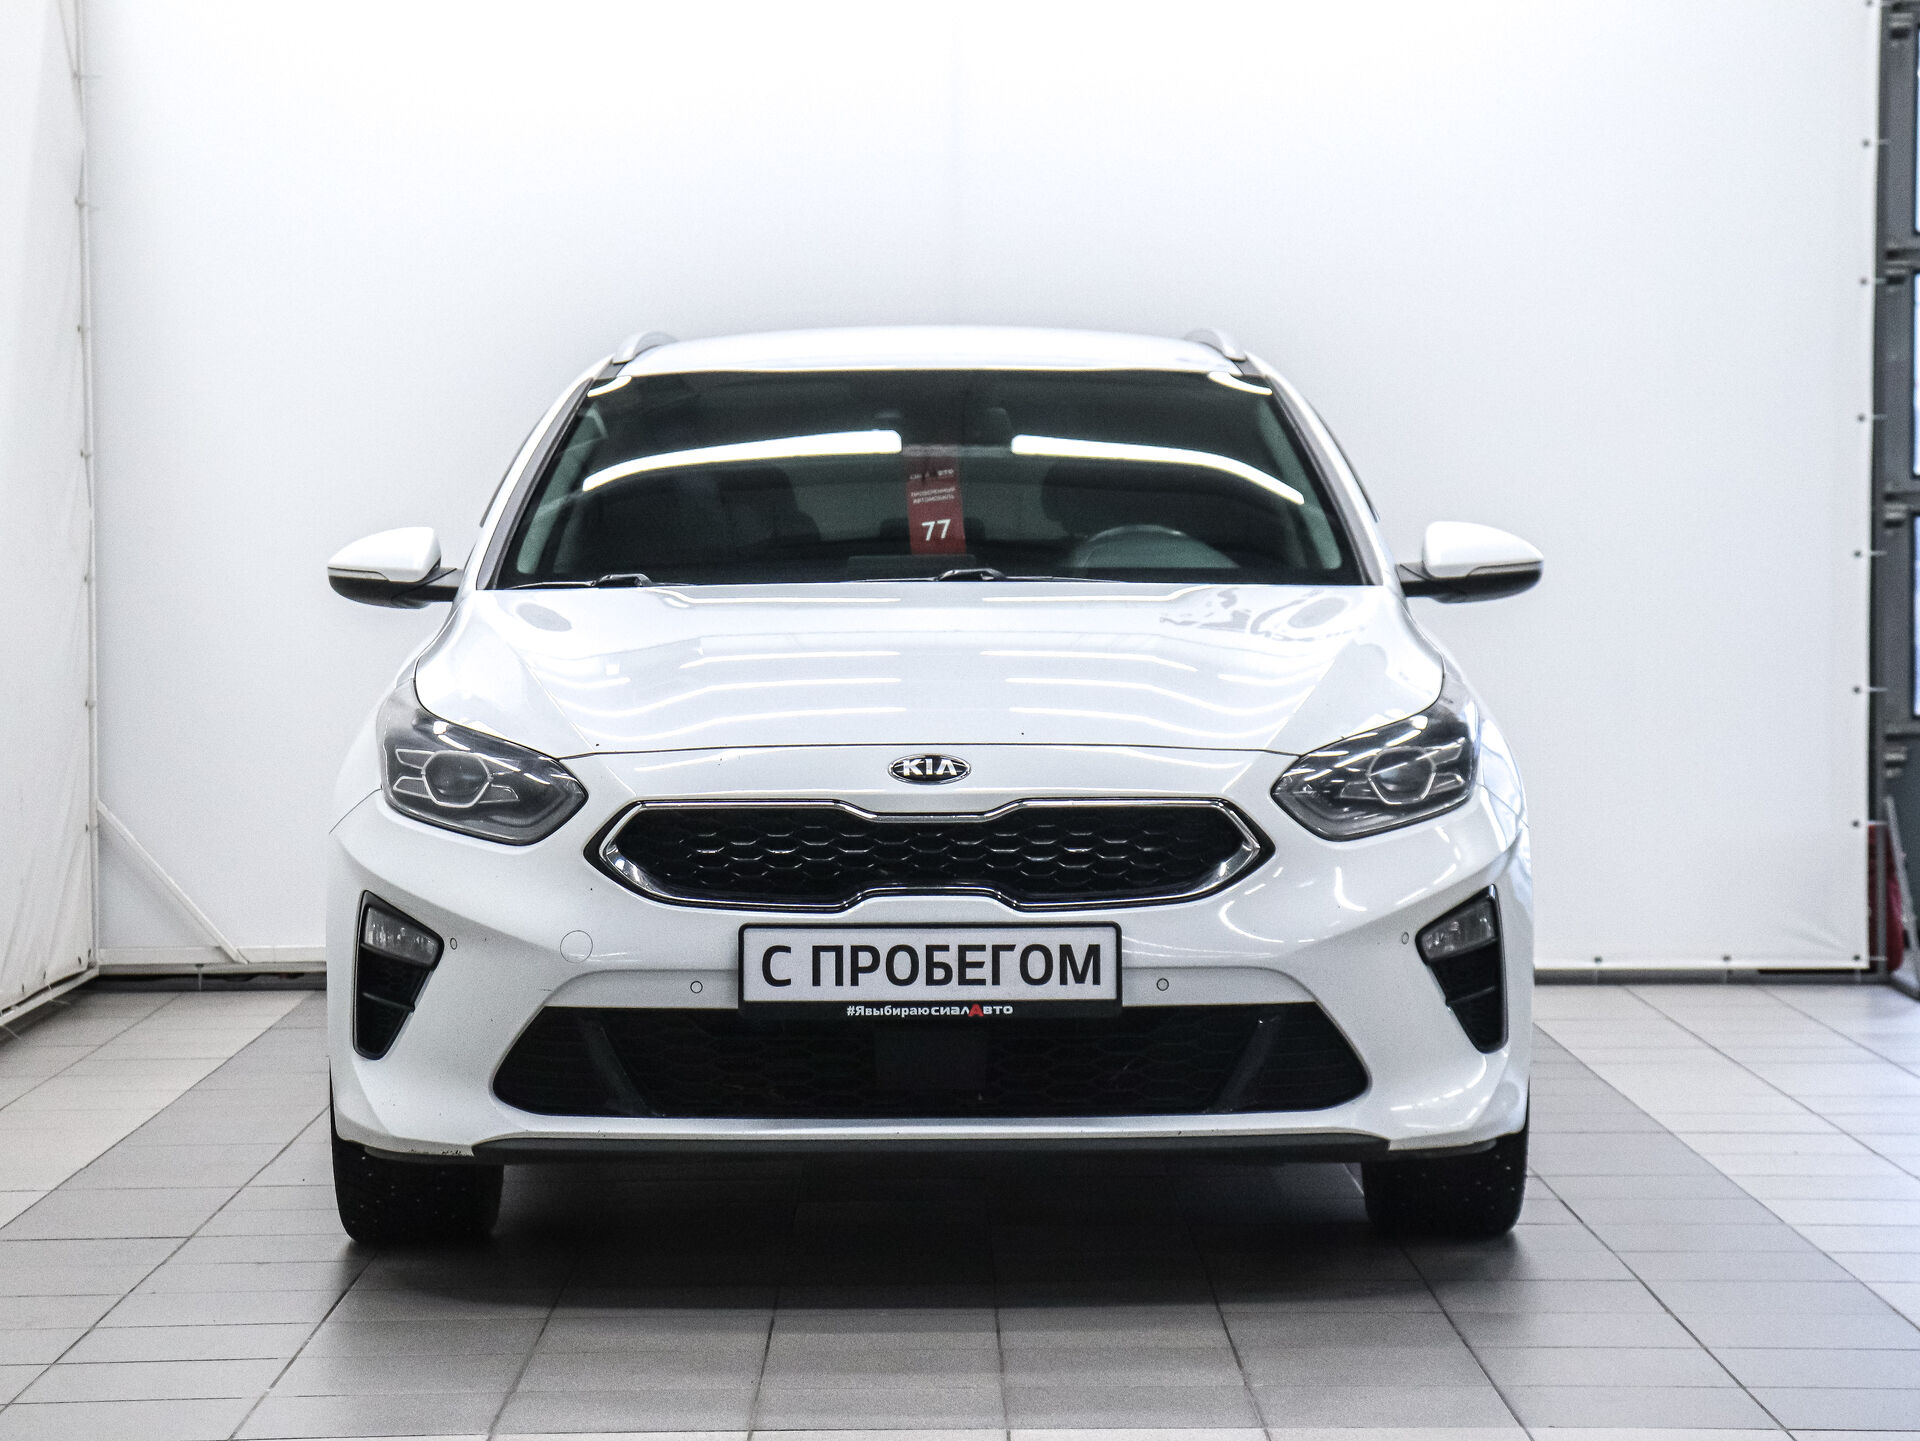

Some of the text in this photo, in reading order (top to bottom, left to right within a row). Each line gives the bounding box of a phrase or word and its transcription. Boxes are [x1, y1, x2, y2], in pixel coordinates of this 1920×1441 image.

[921, 518, 952, 541] 77
[902, 758, 958, 777] KIA
[761, 943, 1101, 987] С ПРОБЕГОМ
